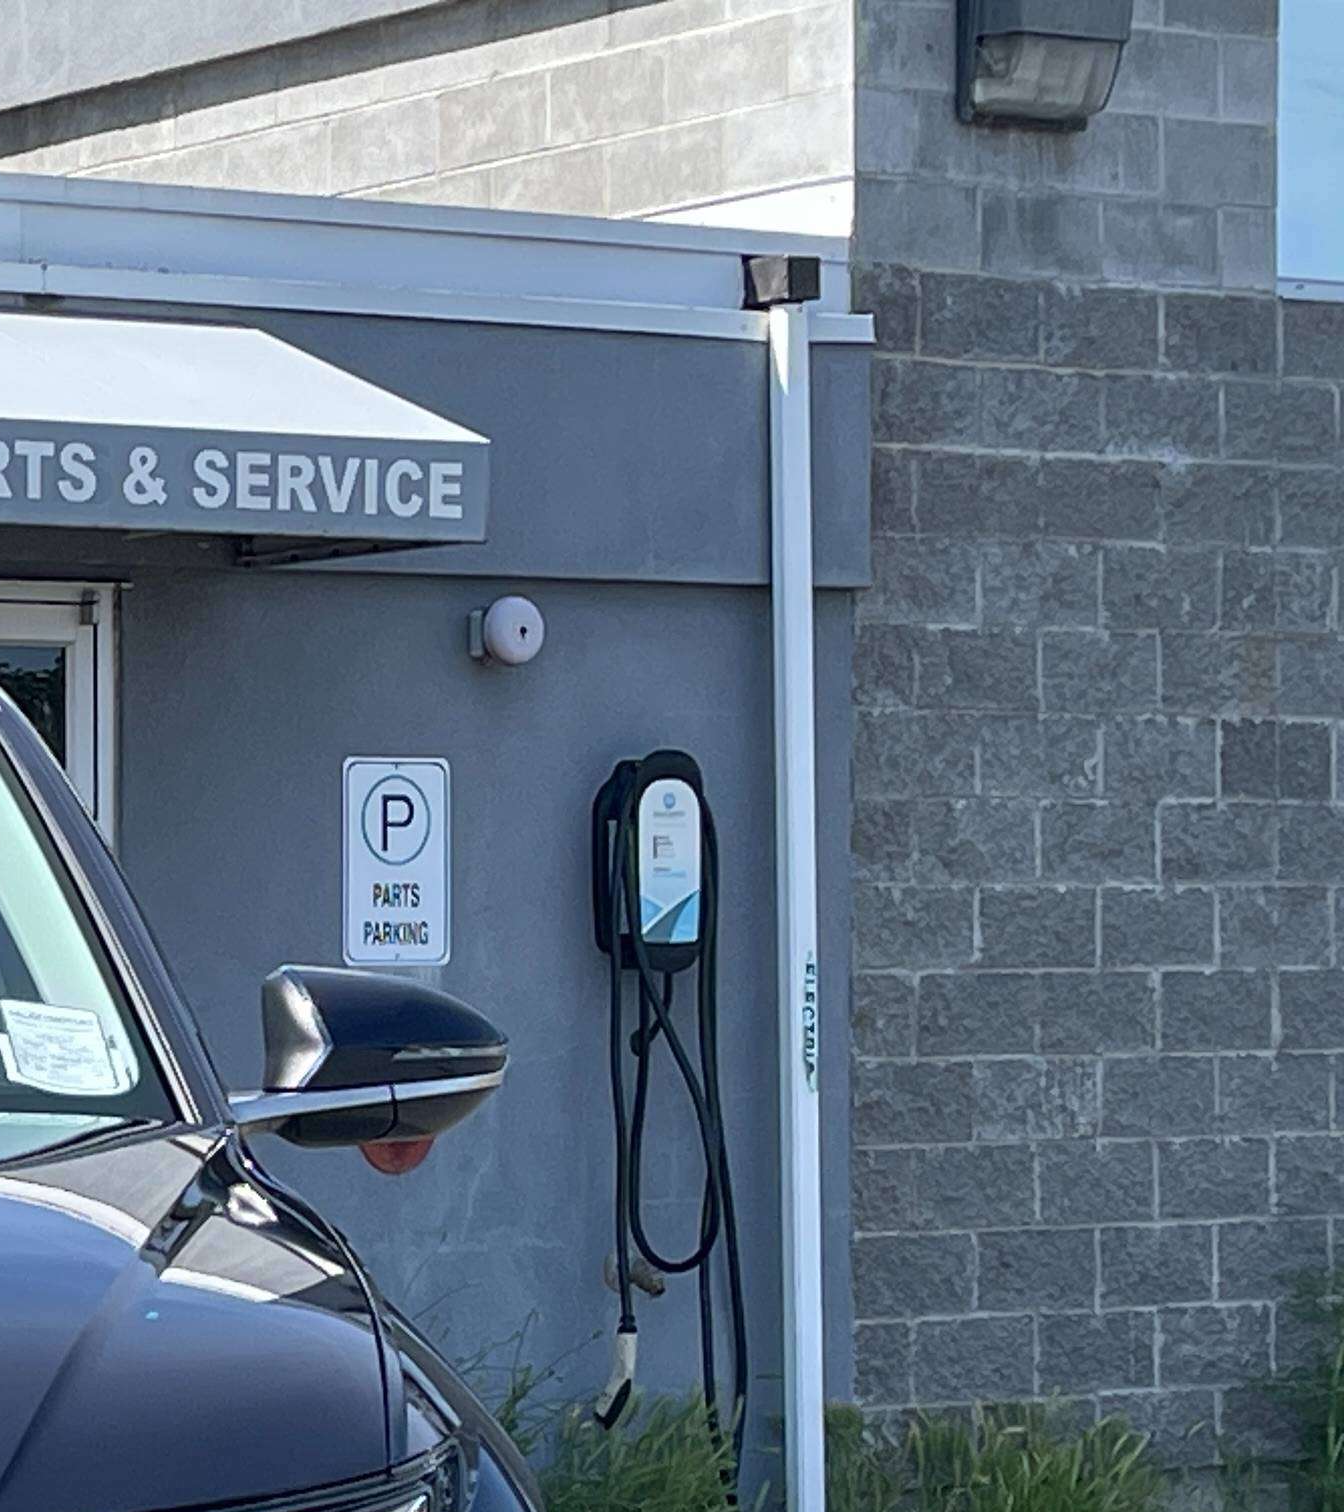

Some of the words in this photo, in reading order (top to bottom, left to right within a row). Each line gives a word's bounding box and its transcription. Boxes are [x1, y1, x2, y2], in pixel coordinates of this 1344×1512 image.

[122, 446, 168, 506] &
[192, 449, 464, 520] SERVICE
[380, 794, 414, 852] P
[372, 883, 421, 908] PARTS
[363, 921, 429, 945] PARKING
